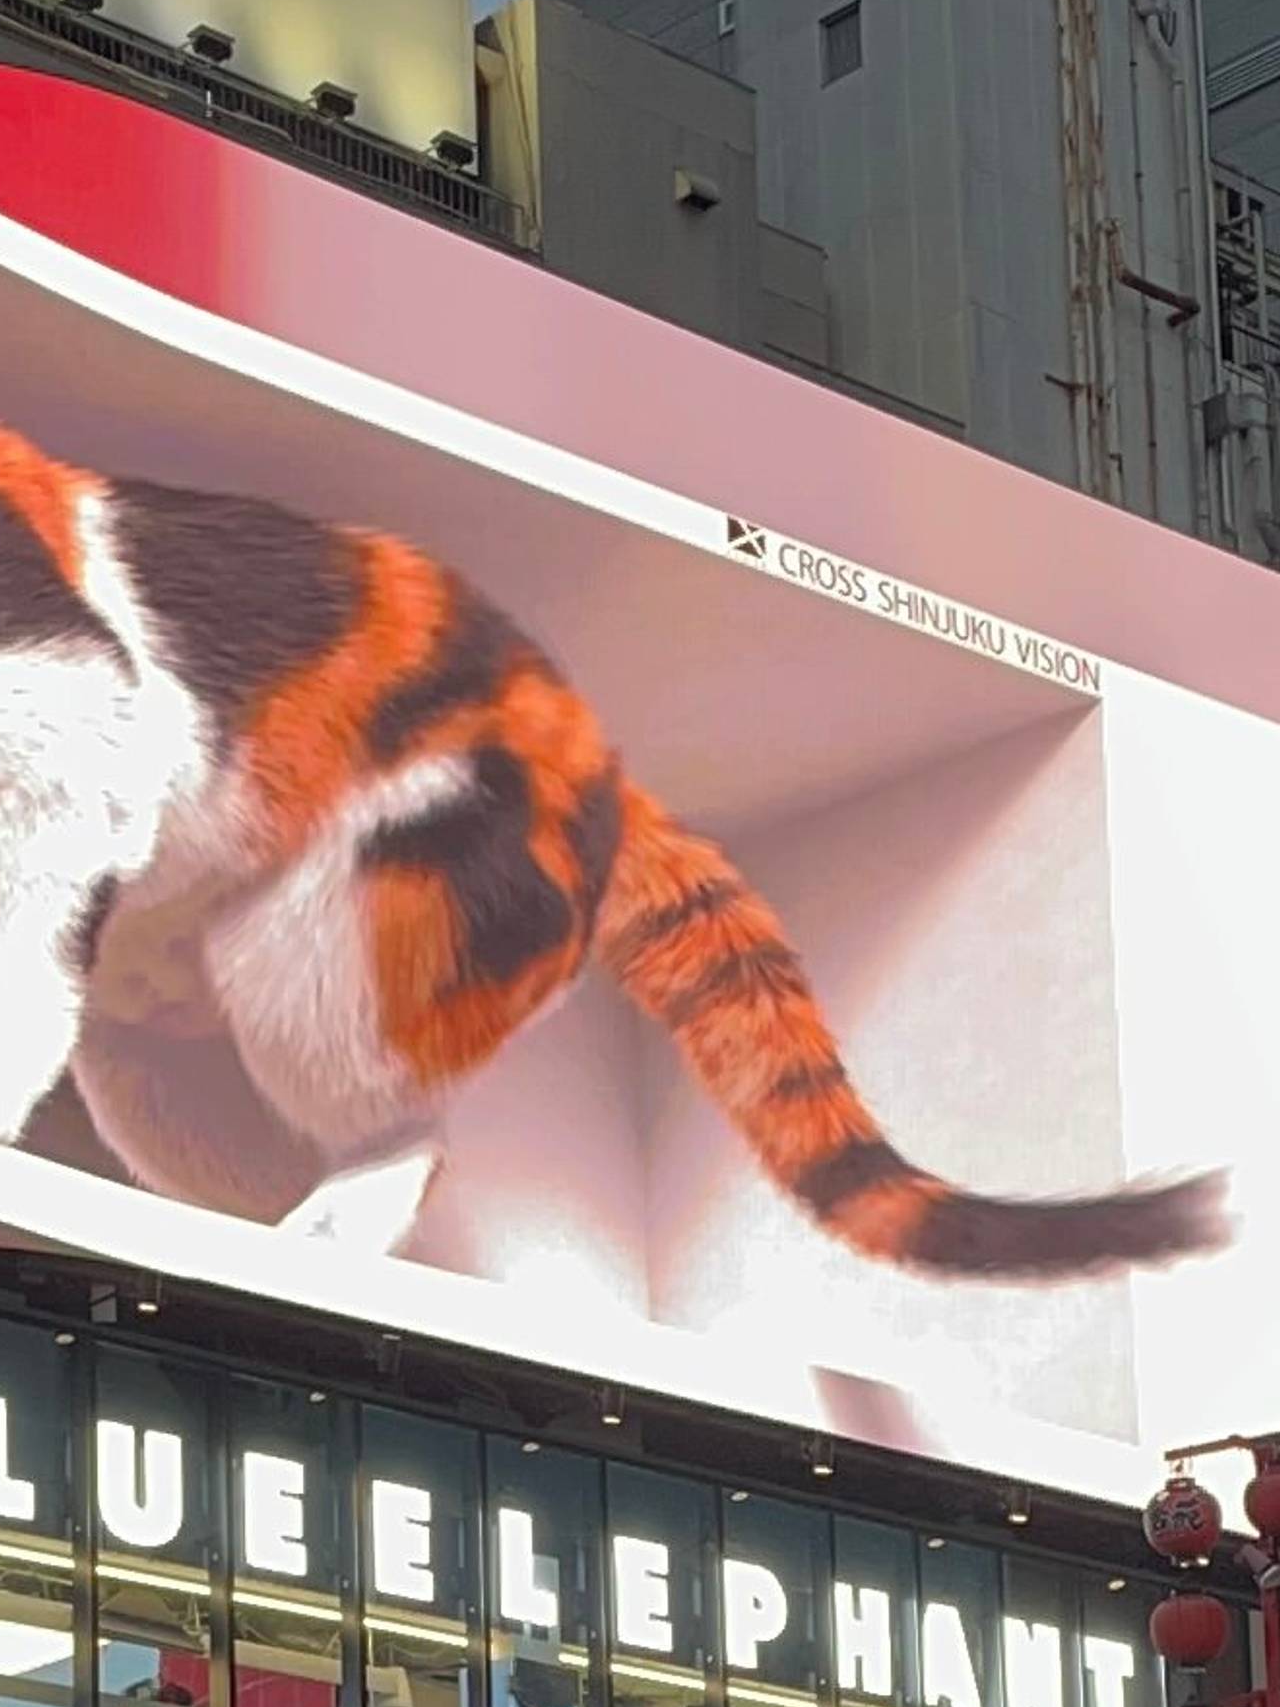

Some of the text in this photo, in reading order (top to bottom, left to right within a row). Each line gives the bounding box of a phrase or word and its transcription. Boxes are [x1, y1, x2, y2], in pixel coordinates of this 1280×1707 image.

[778, 542, 1102, 692] CROSS SHINJUKU VISION
